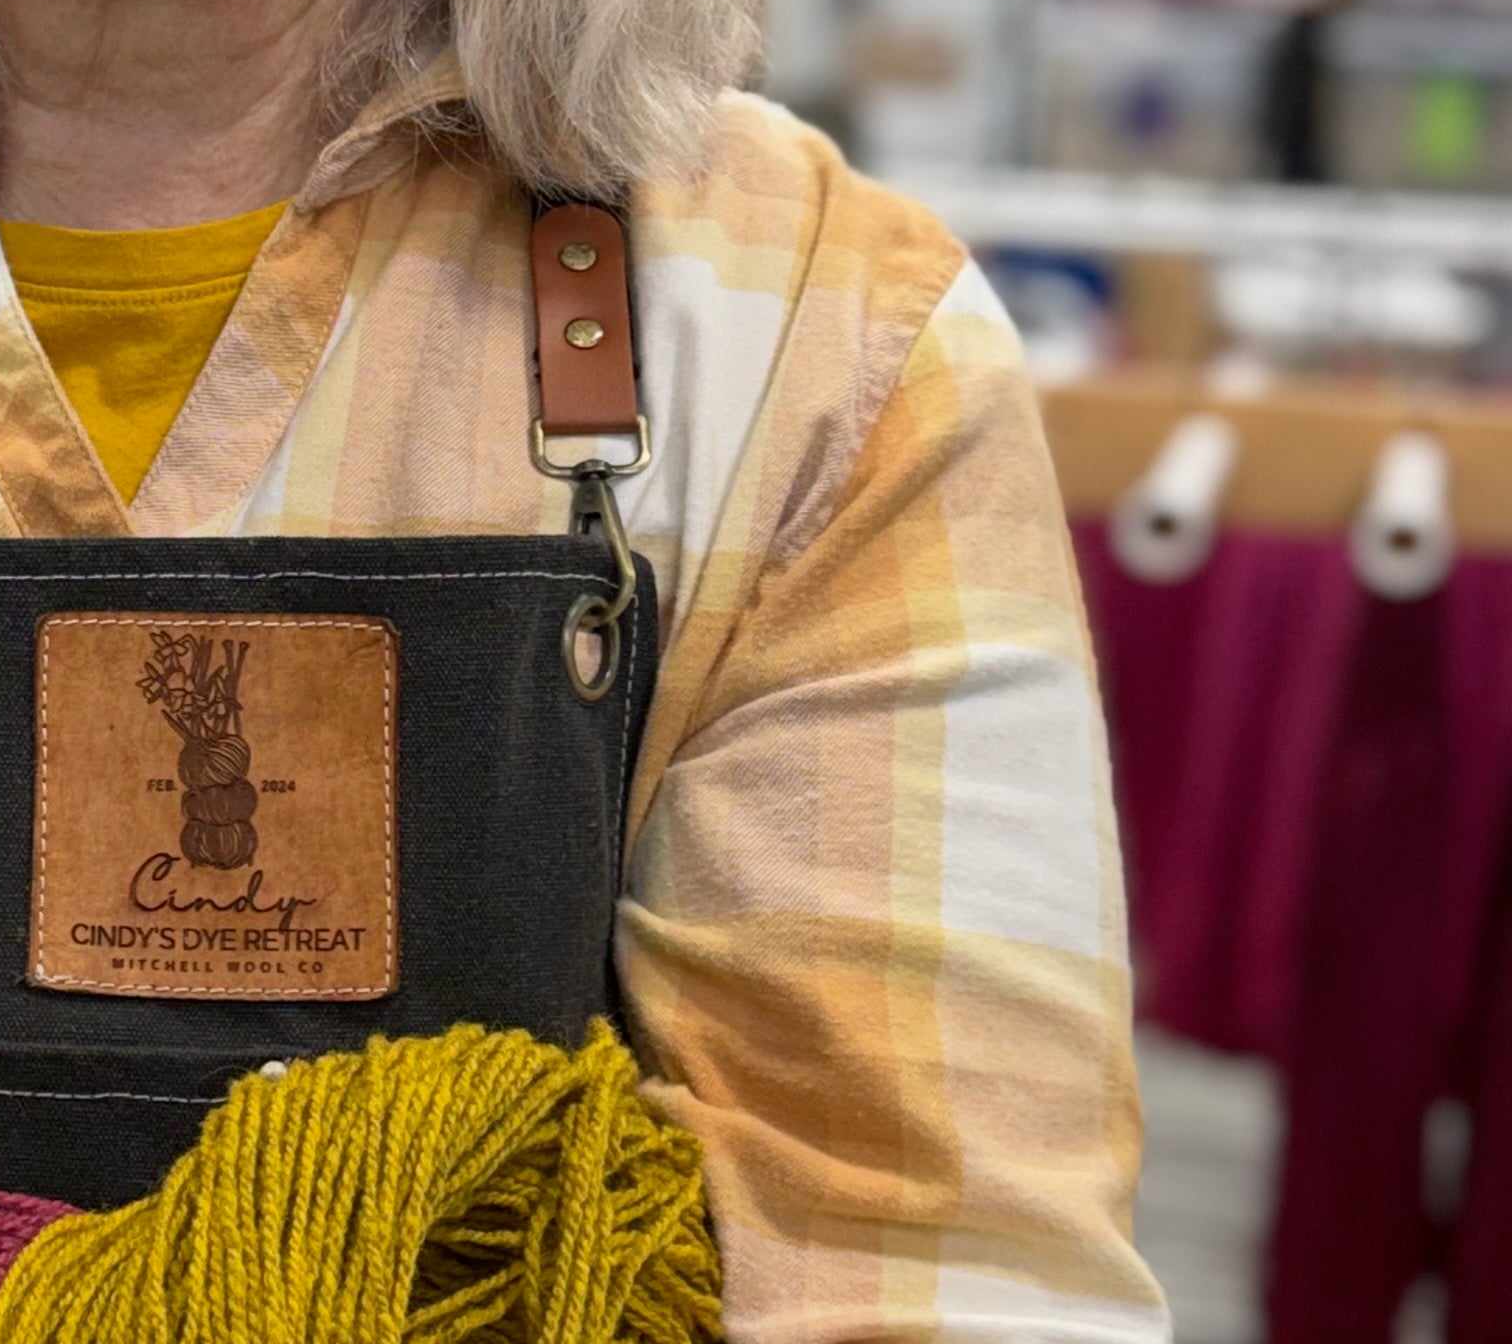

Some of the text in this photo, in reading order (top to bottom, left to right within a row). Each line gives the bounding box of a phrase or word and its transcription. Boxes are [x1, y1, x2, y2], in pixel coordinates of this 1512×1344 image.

[261, 779, 297, 793] 2024
[129, 852, 318, 932] Cindy
[70, 923, 367, 952] CINDY'S DYE RETREAT
[111, 957, 325, 974] MITCHELL WOOL CO
